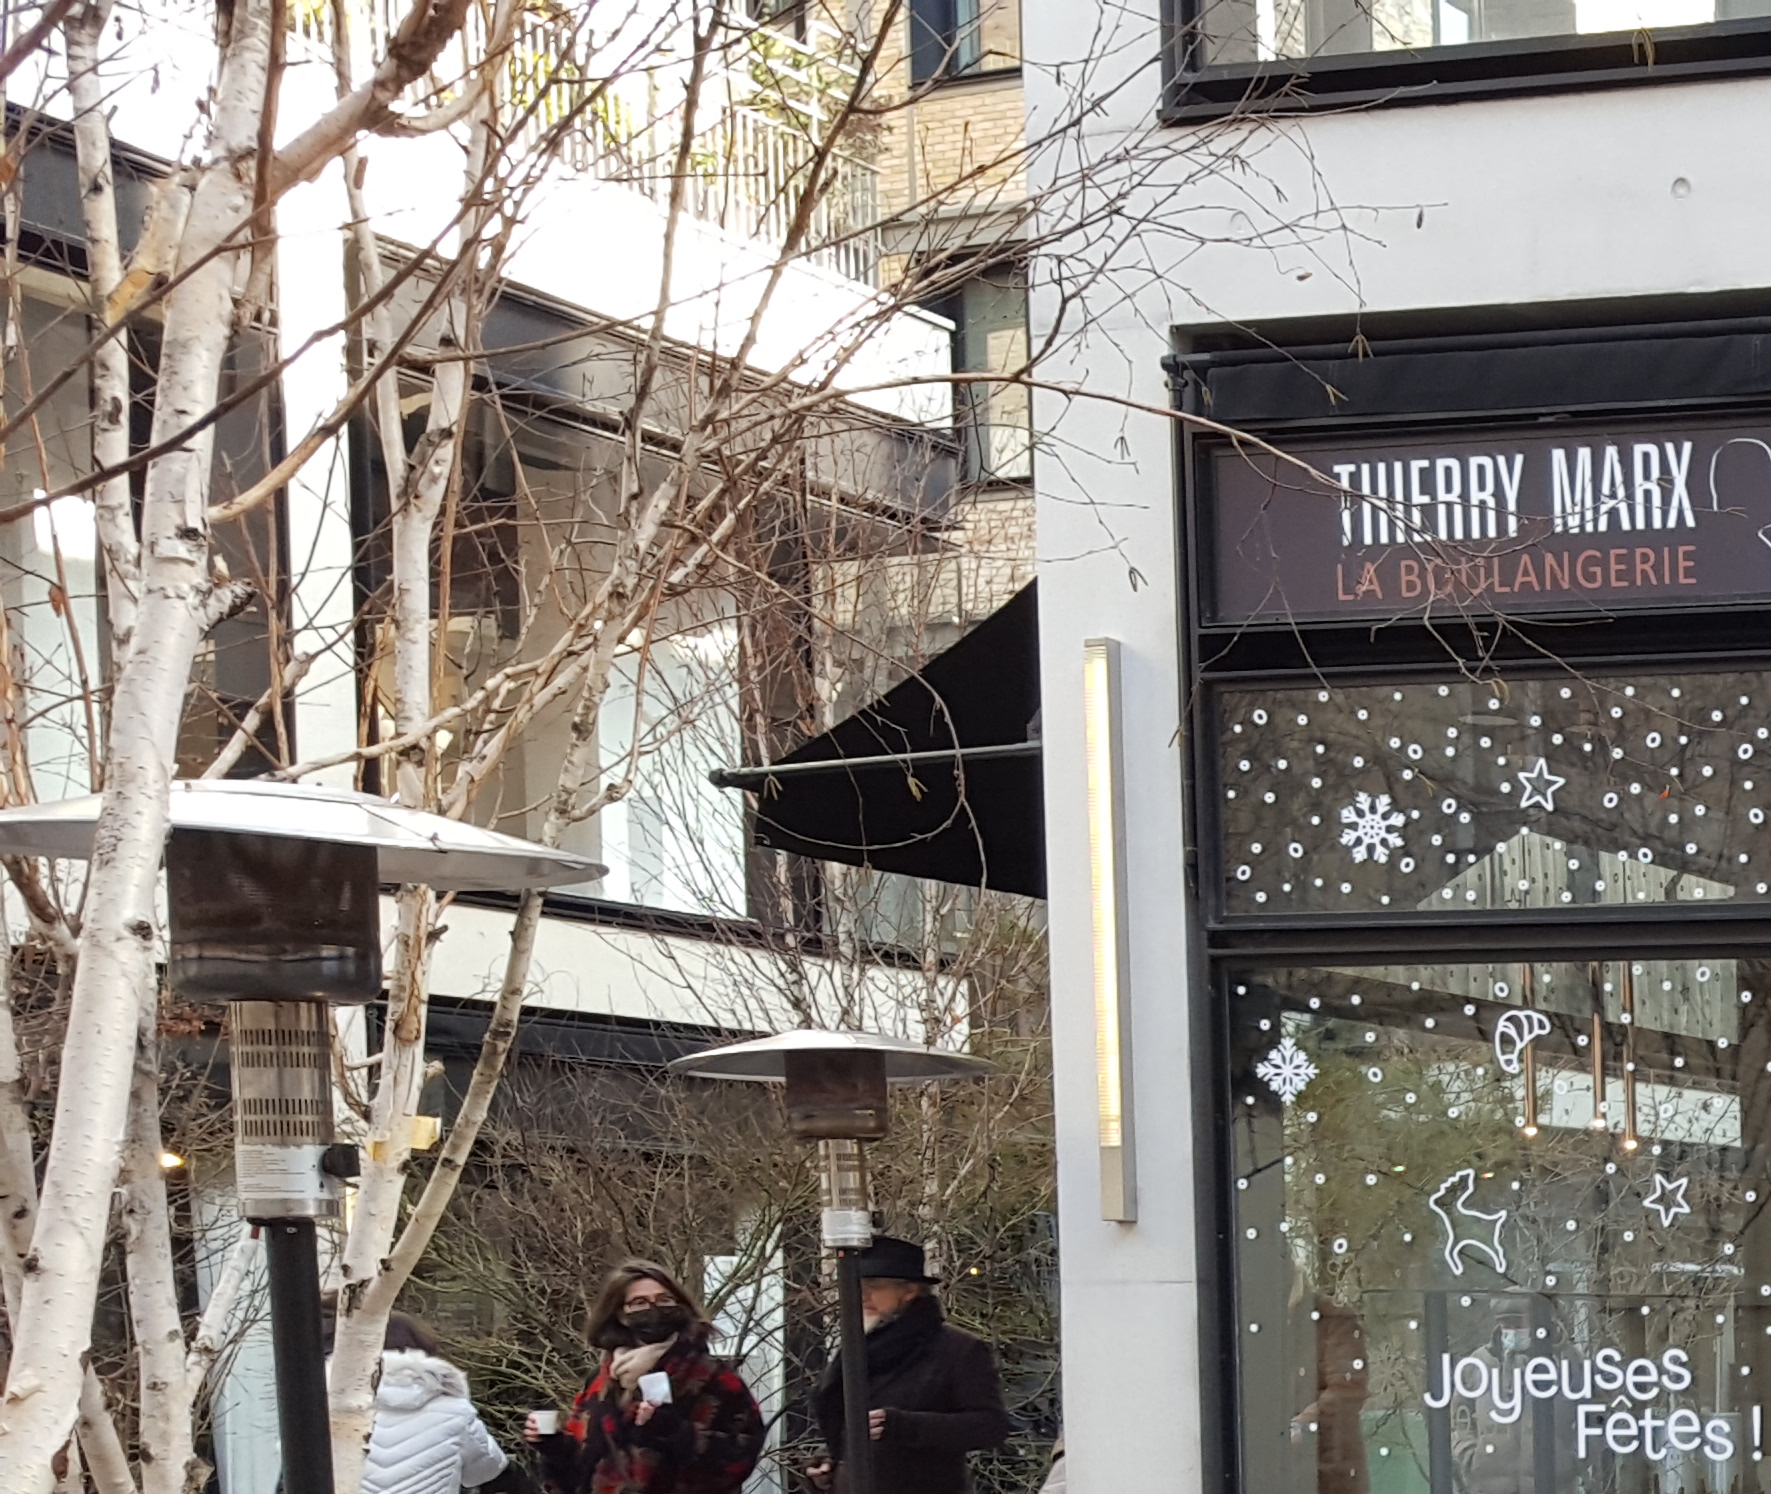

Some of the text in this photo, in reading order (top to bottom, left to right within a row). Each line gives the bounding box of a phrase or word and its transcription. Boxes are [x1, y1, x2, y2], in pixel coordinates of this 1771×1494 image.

[1332, 440, 1697, 547] THIERRY MARX
[1336, 545, 1699, 602] LA BOULANGERIE
[1423, 1348, 1693, 1425] Joyeuses
